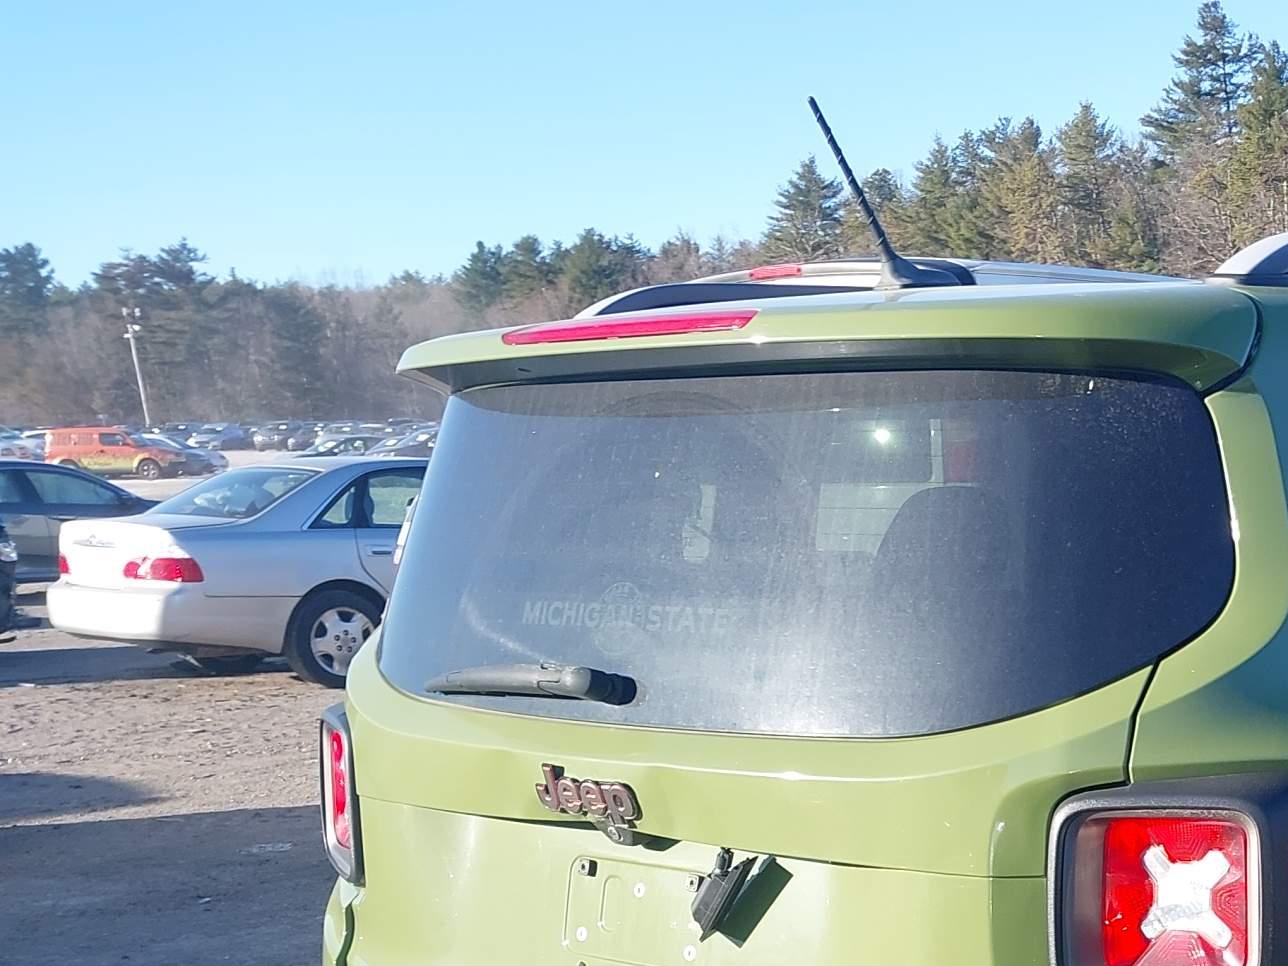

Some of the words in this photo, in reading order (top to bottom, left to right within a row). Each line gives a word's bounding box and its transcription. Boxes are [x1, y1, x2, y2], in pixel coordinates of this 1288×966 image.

[521, 599, 644, 630] MICHIGAN
[646, 604, 730, 634] STATE
[535, 762, 643, 830] Jeep
